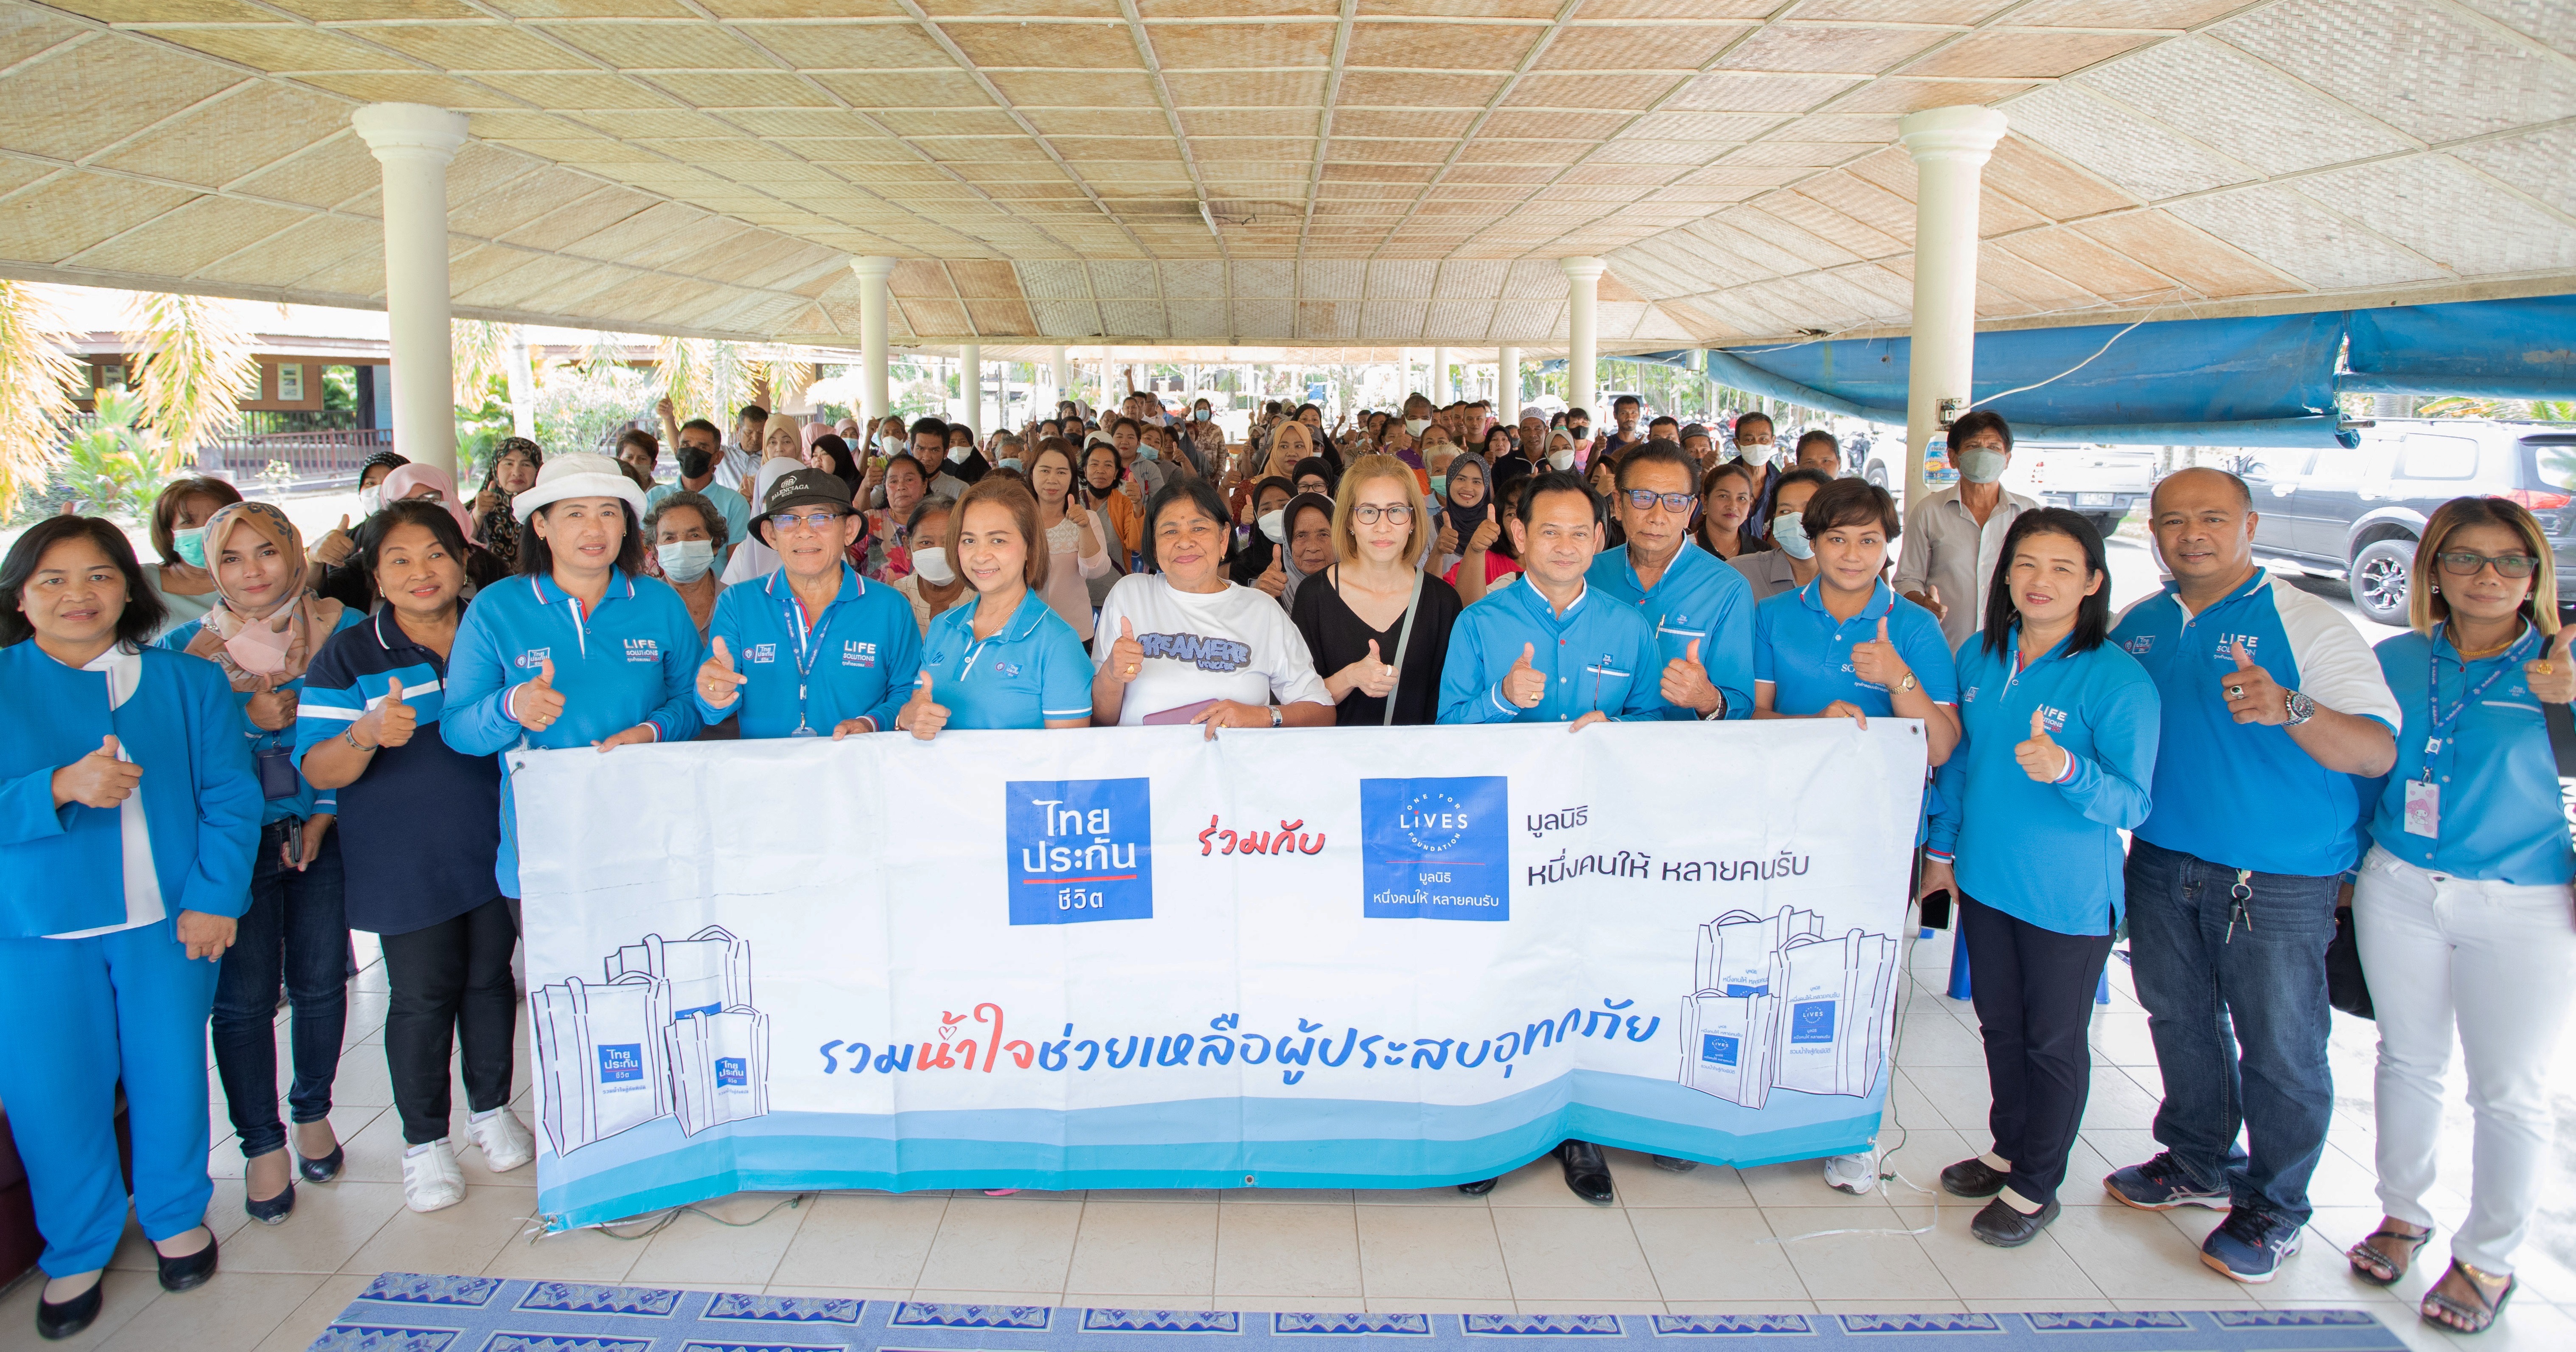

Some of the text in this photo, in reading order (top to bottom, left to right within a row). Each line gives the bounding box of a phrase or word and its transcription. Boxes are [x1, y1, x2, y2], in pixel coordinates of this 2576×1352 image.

[772, 484, 809, 501] BALENCIAGA
[623, 638, 657, 649] LIFE
[844, 640, 876, 654] LIFE
[2219, 632, 2259, 647] LIFE
[843, 652, 875, 661] SOLUTIONS
[2216, 645, 2256, 656] SOLON
[2036, 703, 2068, 722] LIFE
[1407, 793, 1461, 811] ONE FOR
[1032, 799, 1110, 837] ไทย
[1527, 805, 1589, 838] มูลนิธิ
[1198, 814, 1326, 856] ร่วมกับ
[1408, 832, 1461, 852] FOUNDATION
[1022, 837, 1137, 874] ประกัน
[1527, 848, 1810, 886] หนึ่งคนให้ หลายคนรับ
[1419, 871, 1451, 885] มูลนิธิ
[1058, 888, 1104, 911] ชีวิต
[1373, 889, 1499, 908] หนึ่งคนให้ หลายคนรับ
[606, 1049, 631, 1060] ไทย
[604, 1059, 639, 1069] ประกัน
[719, 1068, 744, 1077] ประกัน
[721, 1060, 738, 1069] ไทย
